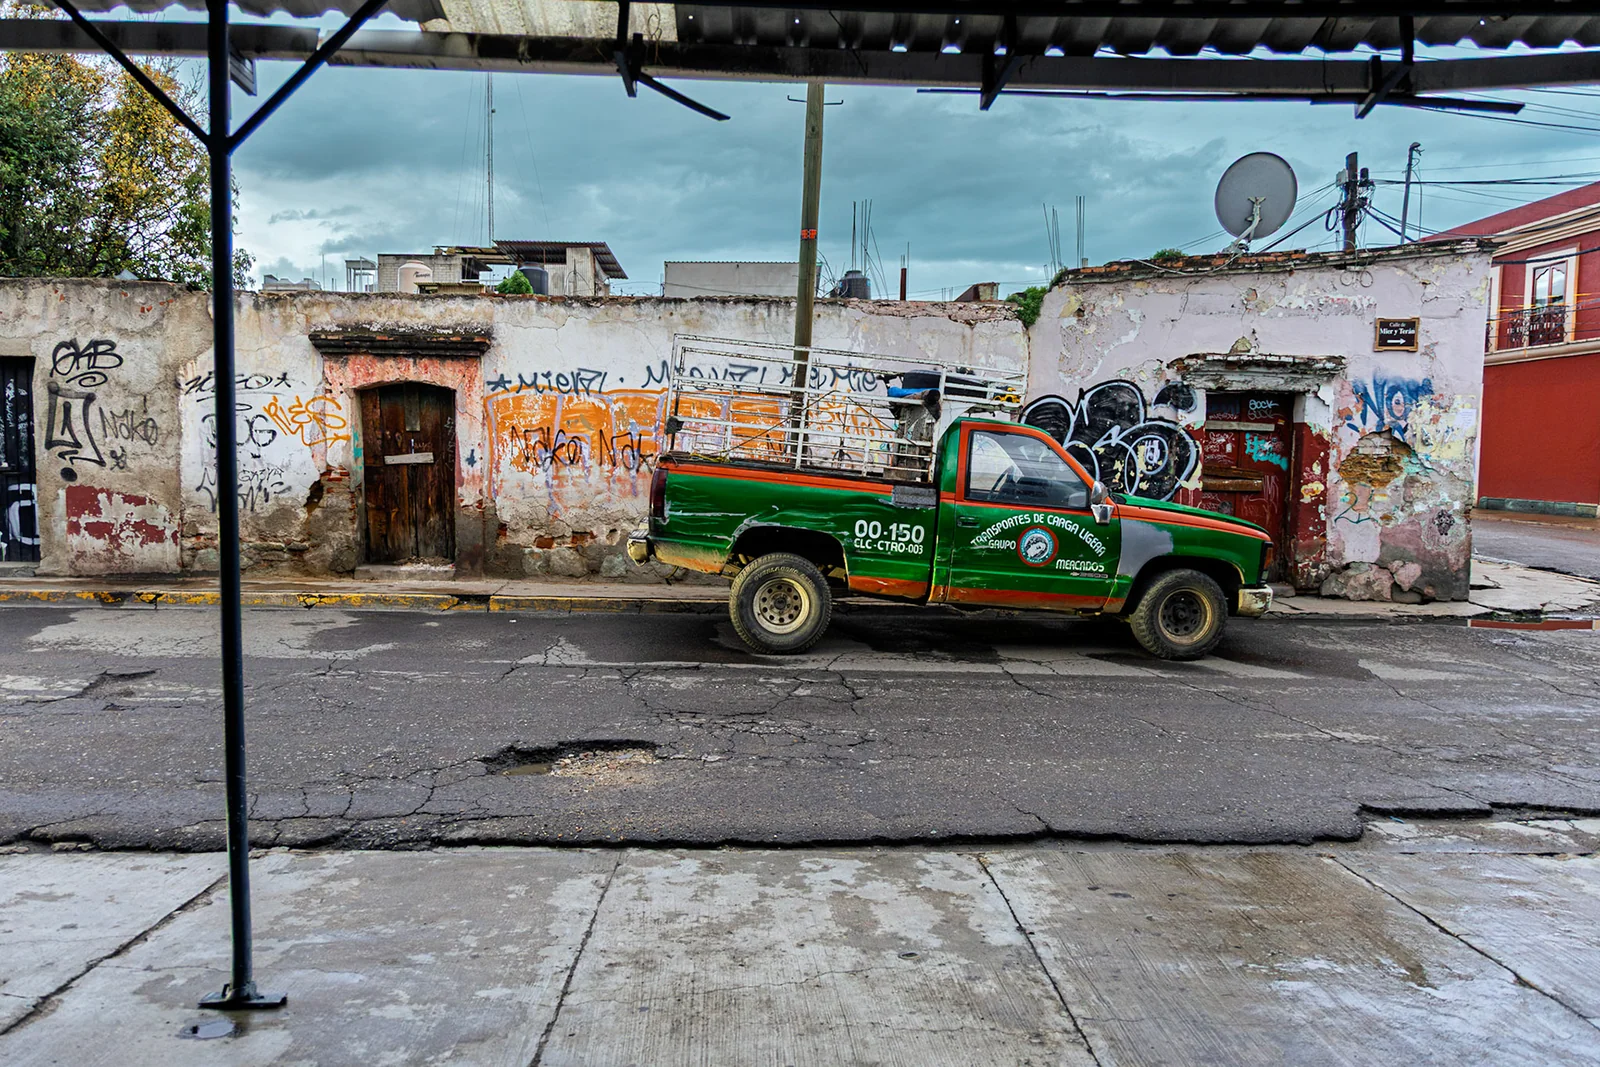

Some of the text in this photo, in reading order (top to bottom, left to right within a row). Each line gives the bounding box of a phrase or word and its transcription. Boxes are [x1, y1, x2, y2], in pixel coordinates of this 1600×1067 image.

[1380, 327, 1393, 335] Mier
[854, 519, 925, 543] 00-150
[970, 513, 1031, 546] TRANSPORTES
[1033, 513, 1045, 524] DE
[1047, 514, 1079, 535] CARGA
[1079, 528, 1106, 557] LIGERA
[988, 540, 1017, 550] GRUPO
[1056, 559, 1104, 572] MERCADOS
